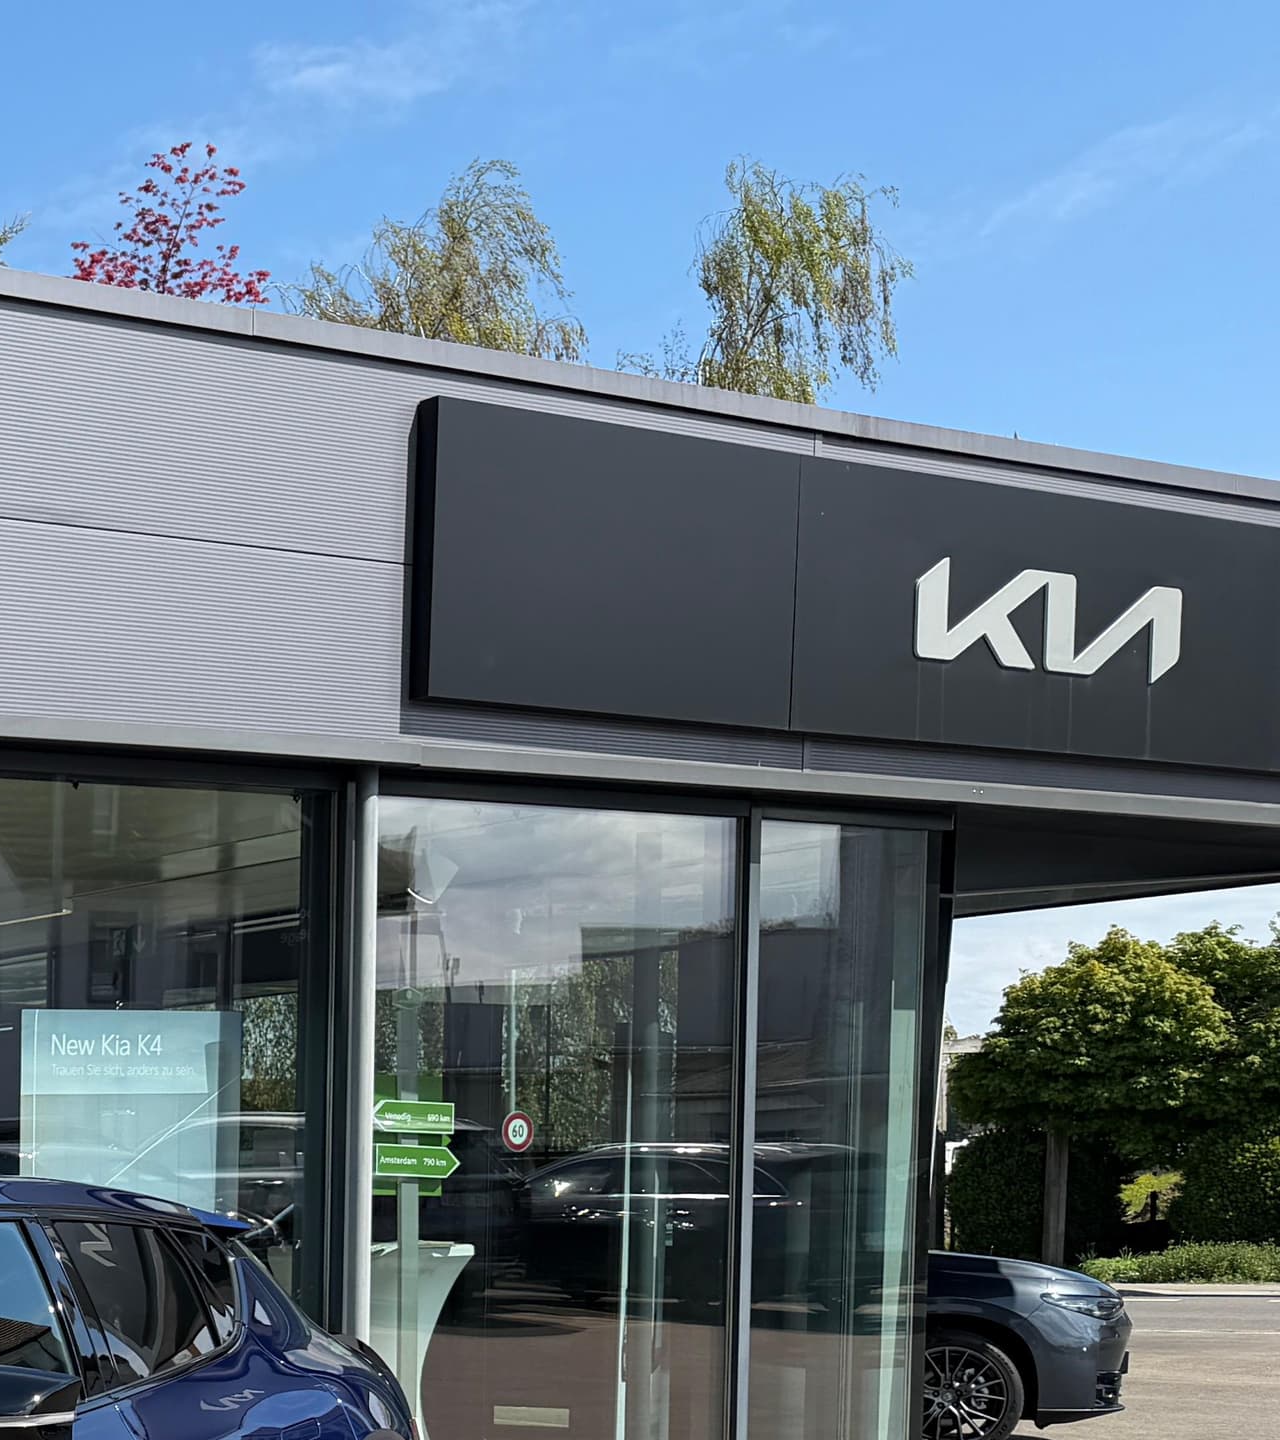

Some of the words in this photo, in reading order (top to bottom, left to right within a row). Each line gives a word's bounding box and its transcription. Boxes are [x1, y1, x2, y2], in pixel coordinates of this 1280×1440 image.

[914, 556, 1183, 685] KIA
[51, 1033, 95, 1056] New
[101, 1033, 130, 1056] Kia
[138, 1033, 163, 1056] K4
[512, 1124, 525, 1138] 60
[379, 1155, 417, 1165] Amsterdam
[436, 1158, 447, 1166] km
